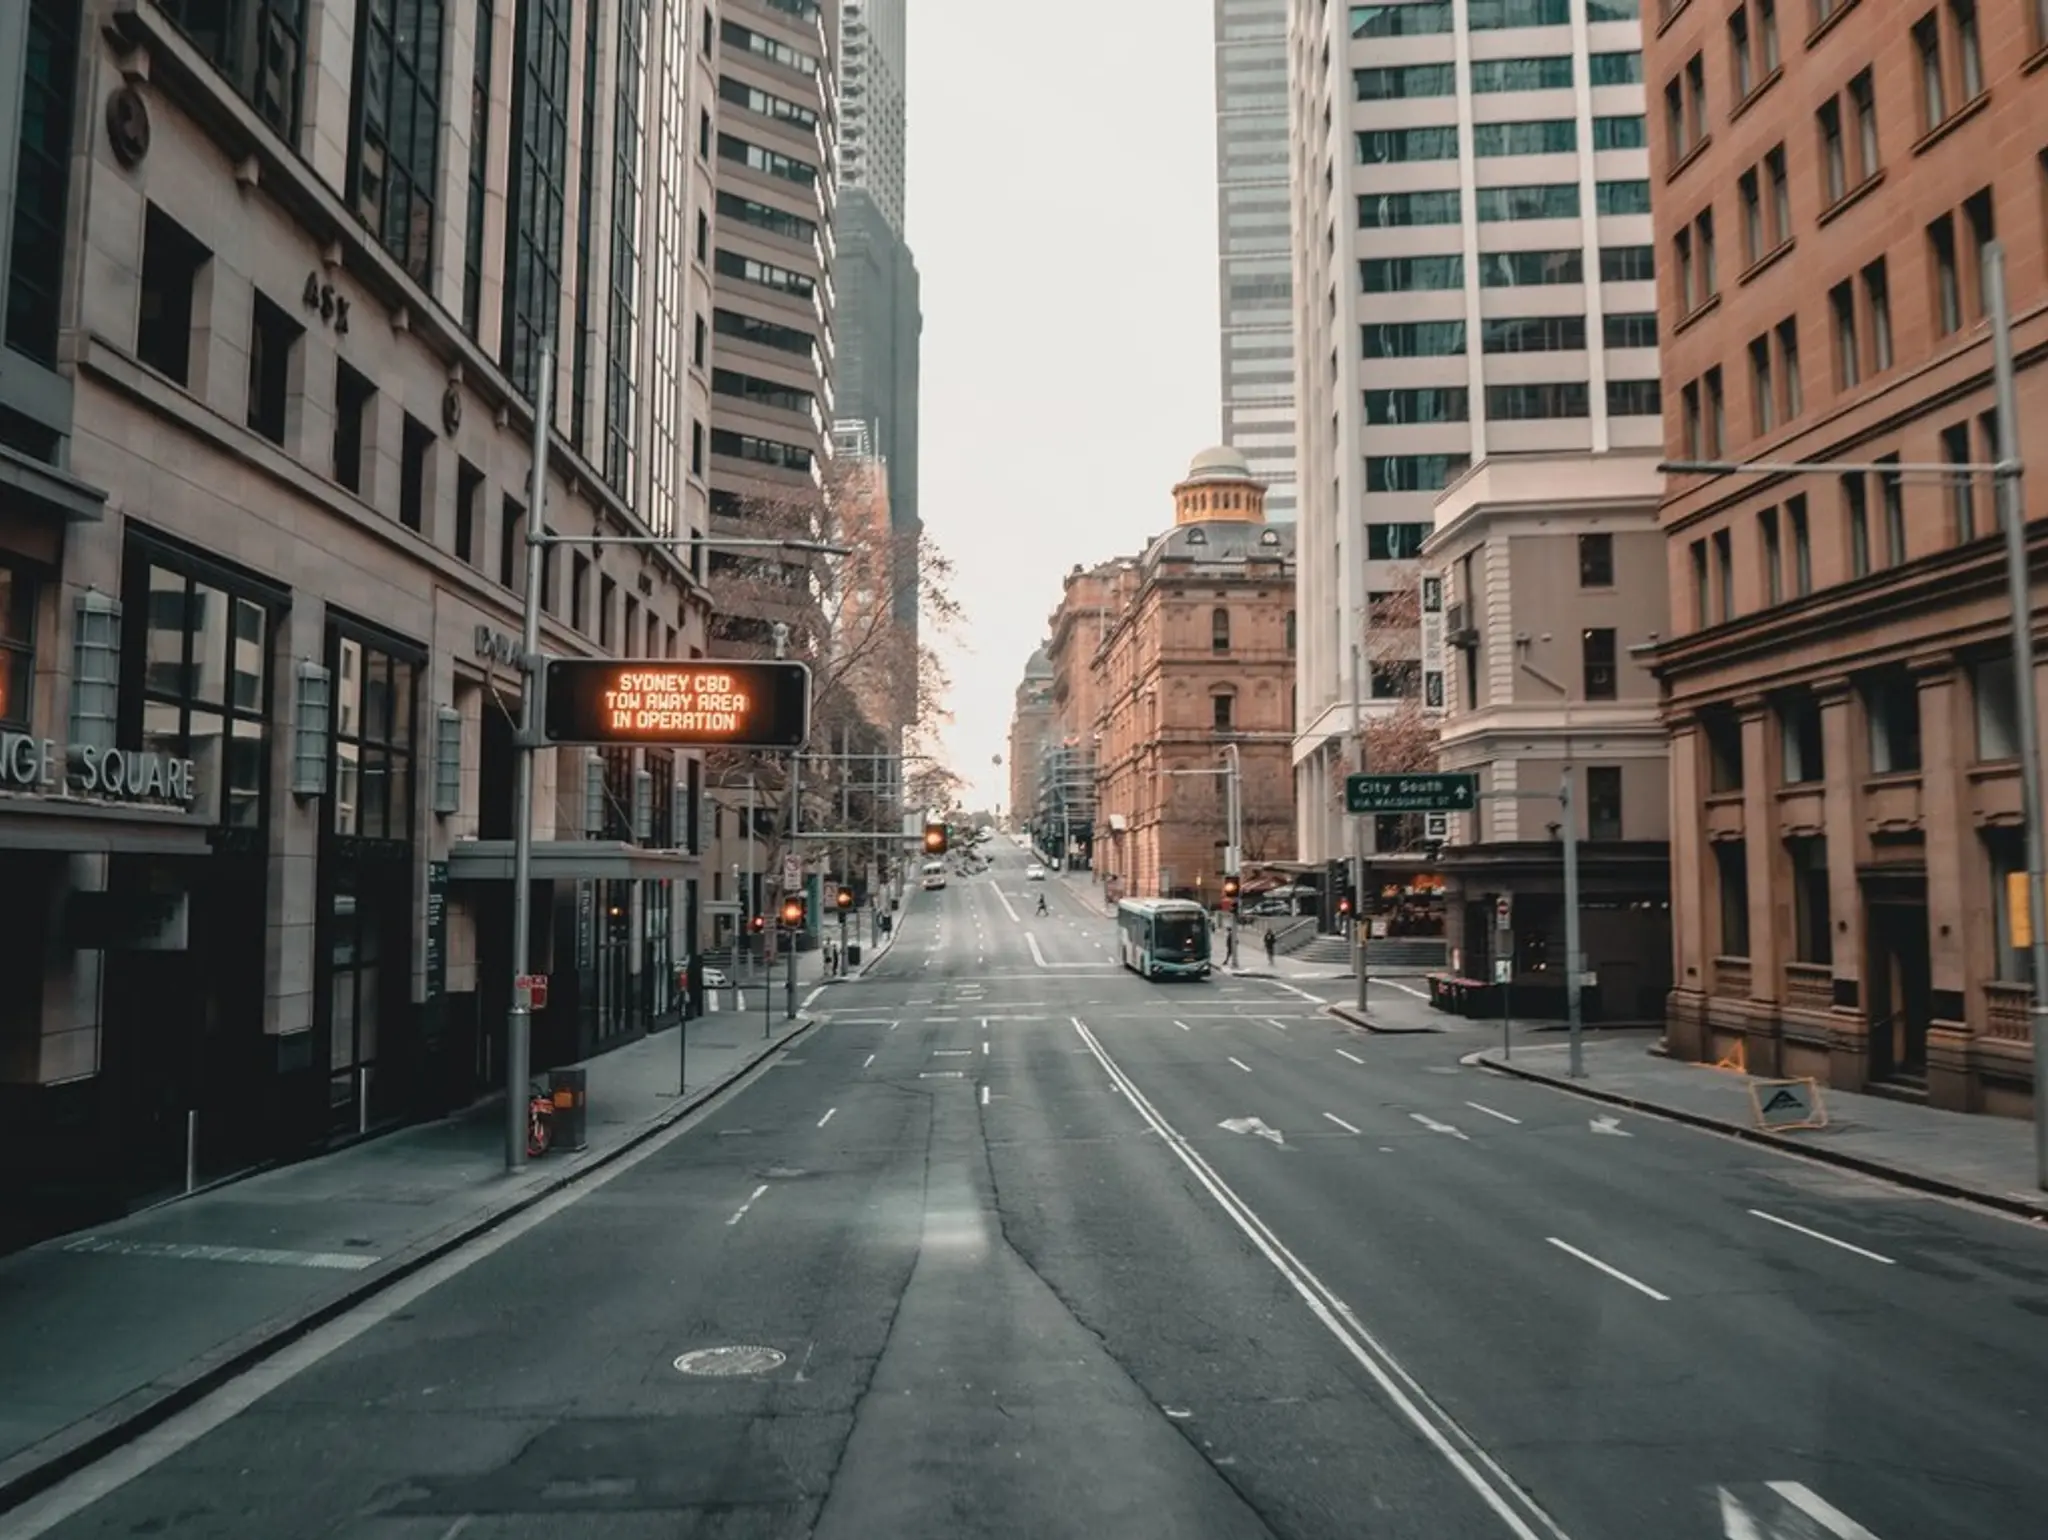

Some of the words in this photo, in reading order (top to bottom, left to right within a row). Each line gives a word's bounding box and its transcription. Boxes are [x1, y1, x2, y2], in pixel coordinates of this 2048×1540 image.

[302, 269, 350, 335] ASX
[619, 673, 690, 692] SYDNEY
[694, 675, 730, 693] CBD
[605, 691, 640, 709] TOW
[646, 692, 692, 711] AWAY
[697, 693, 746, 712] AREA
[612, 711, 631, 728] IN
[637, 711, 735, 730] OPERATION
[82, 744, 195, 800] SQUARE
[1358, 781, 1391, 795] City
[1399, 779, 1443, 793] South
